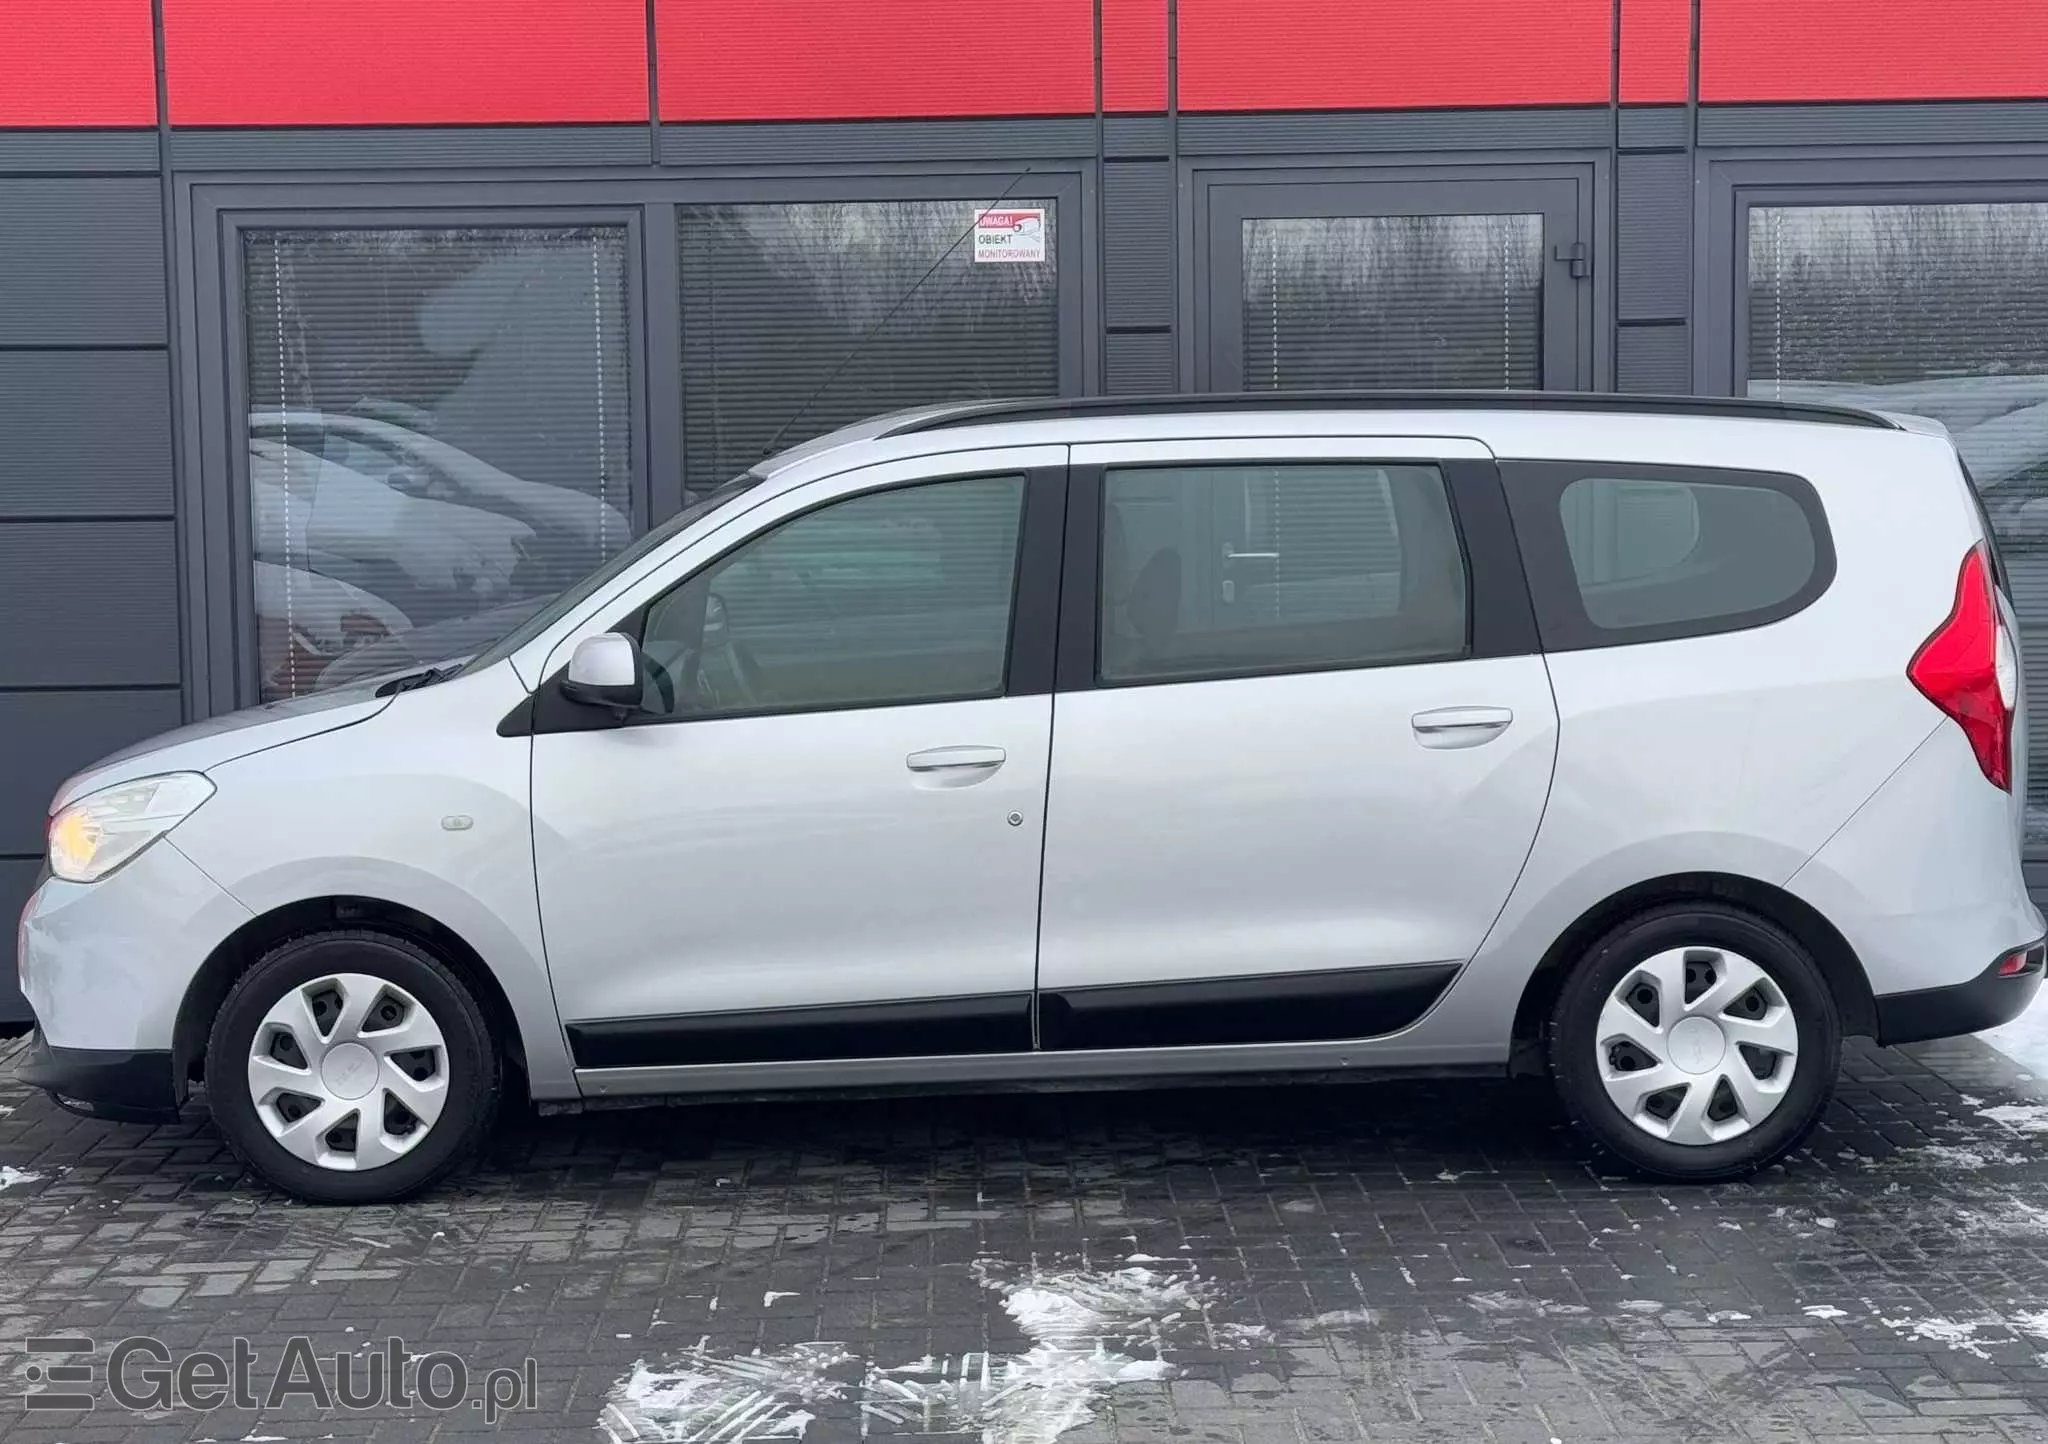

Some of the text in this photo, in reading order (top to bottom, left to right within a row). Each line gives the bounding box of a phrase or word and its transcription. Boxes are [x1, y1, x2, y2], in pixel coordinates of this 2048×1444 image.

[980, 215, 1013, 226] UWAGA!
[978, 234, 1012, 245] OBIEKT
[978, 249, 1040, 258] MONITOROWANY
